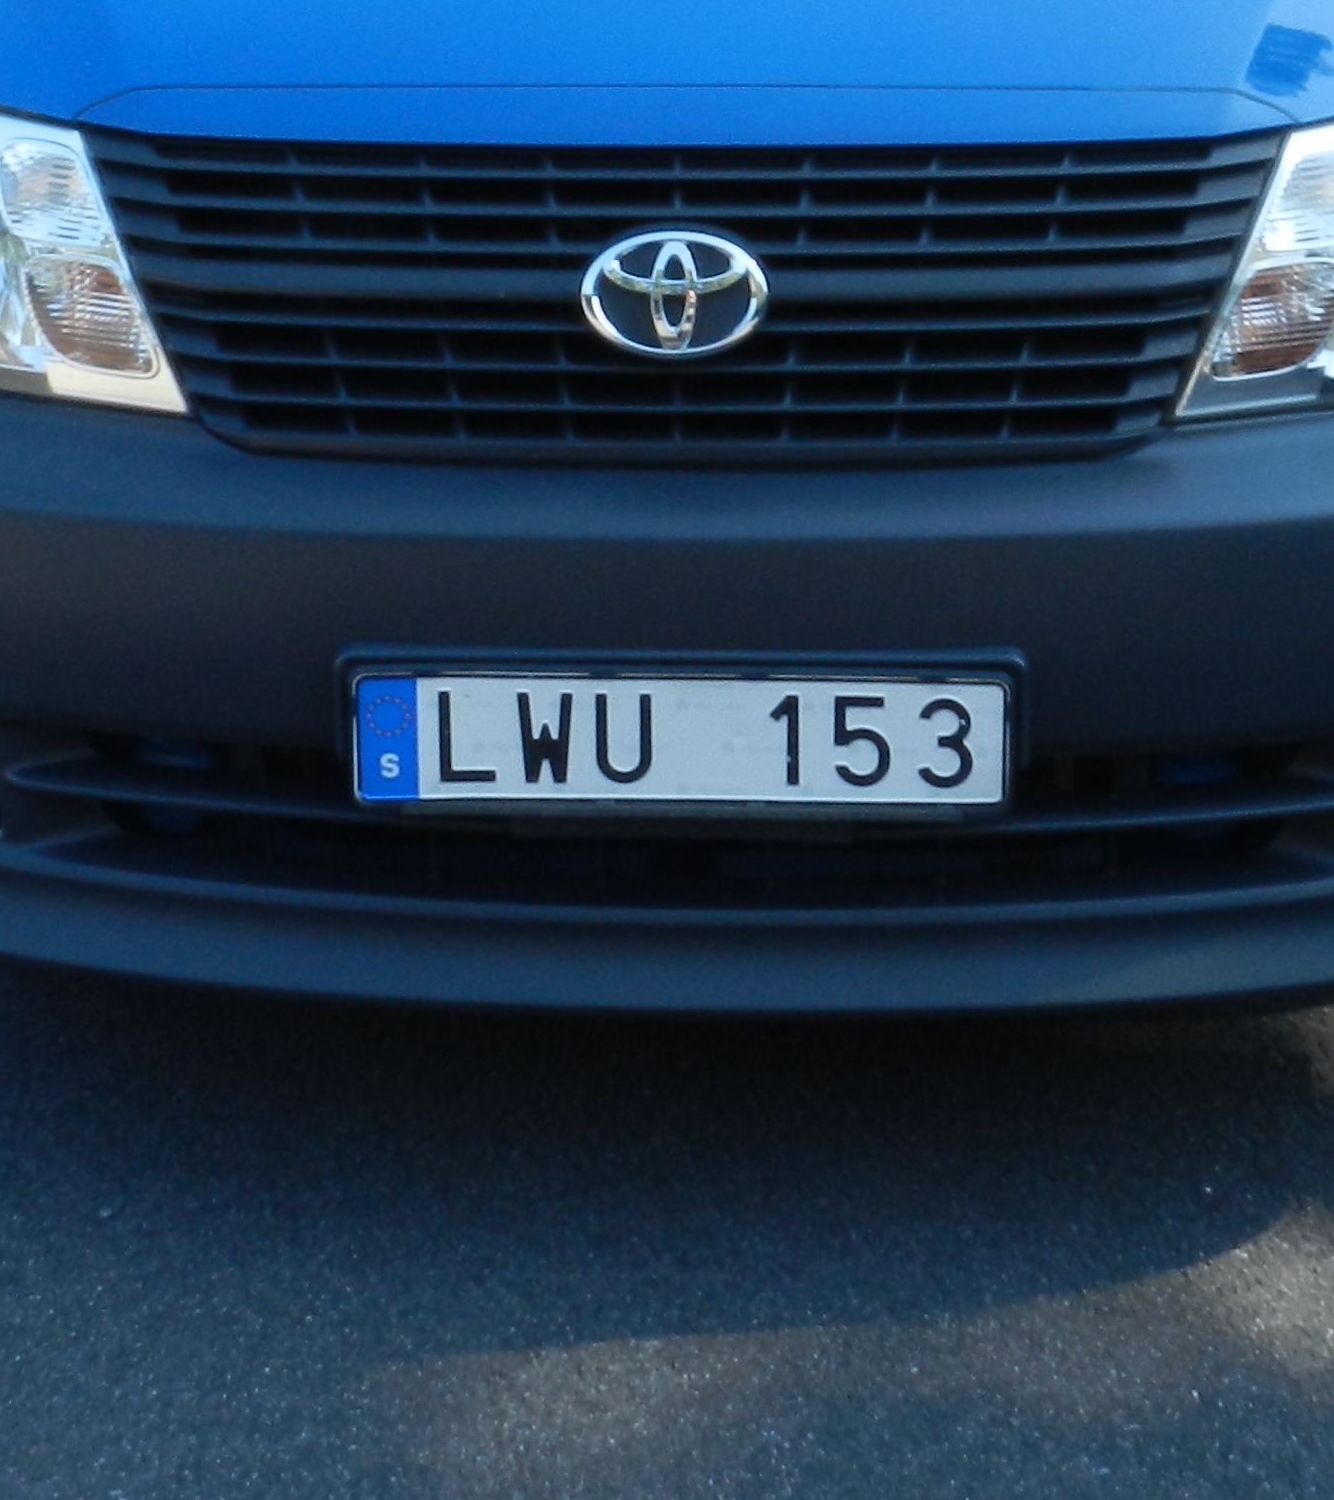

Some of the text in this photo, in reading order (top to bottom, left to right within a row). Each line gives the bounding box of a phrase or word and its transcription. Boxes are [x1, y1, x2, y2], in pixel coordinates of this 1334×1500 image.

[379, 753, 400, 779] S
[436, 689, 974, 790] LWU 153
